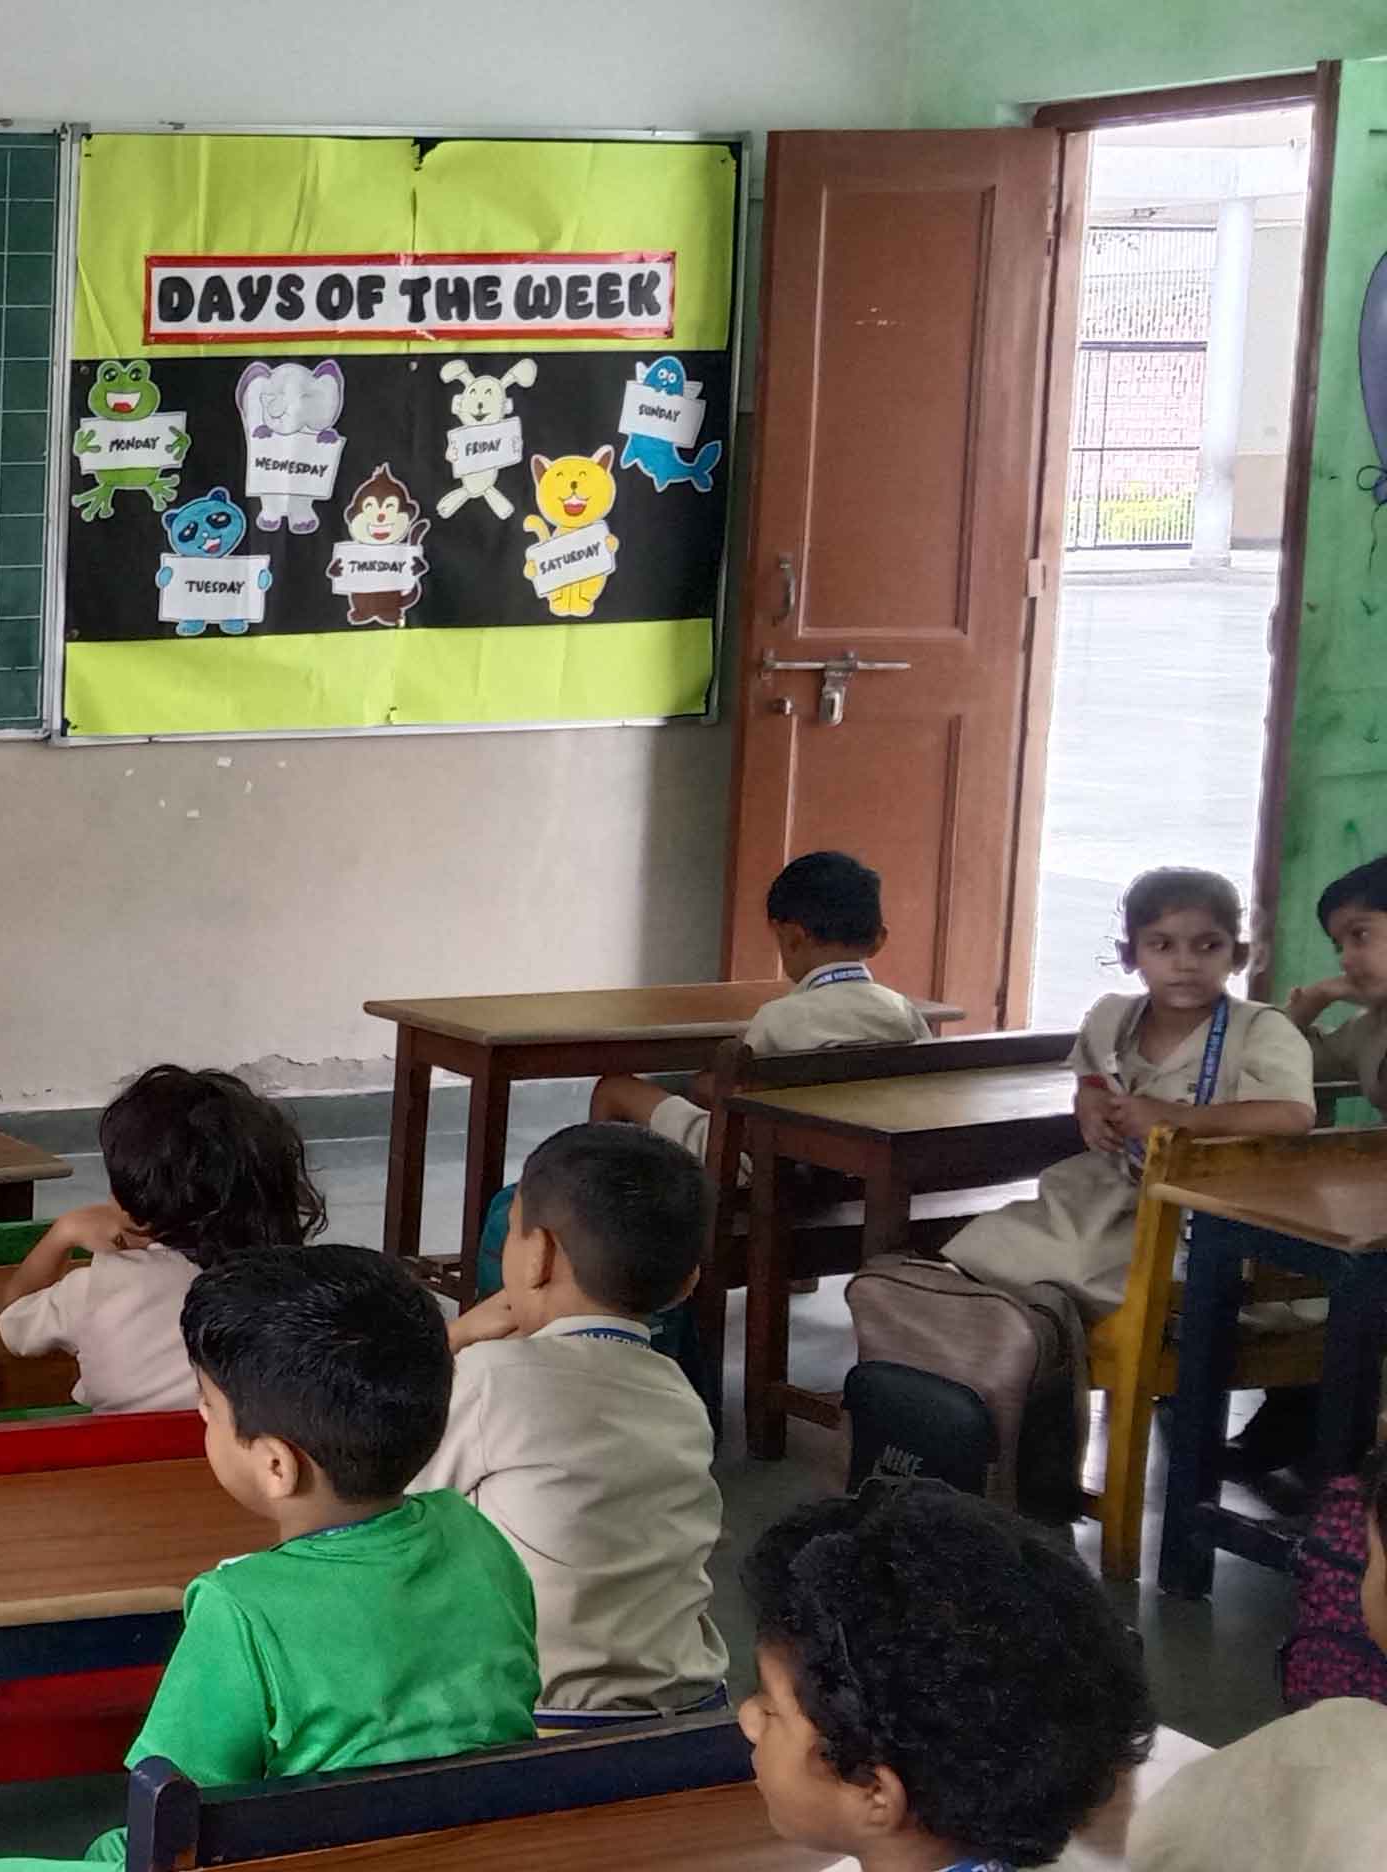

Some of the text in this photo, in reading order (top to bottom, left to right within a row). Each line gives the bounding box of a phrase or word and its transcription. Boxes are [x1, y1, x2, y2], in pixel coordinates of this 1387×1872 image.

[157, 270, 662, 324] DAYS OF THE WEEK
[637, 403, 682, 423] SUNDAY
[108, 435, 161, 453] MONDAY
[465, 438, 503, 457] FRIDAY
[254, 456, 328, 478] WEDNESDAY
[348, 560, 407, 573] THURSDAY
[539, 541, 602, 575] SATURDAY
[184, 579, 246, 595] TUESDAY
